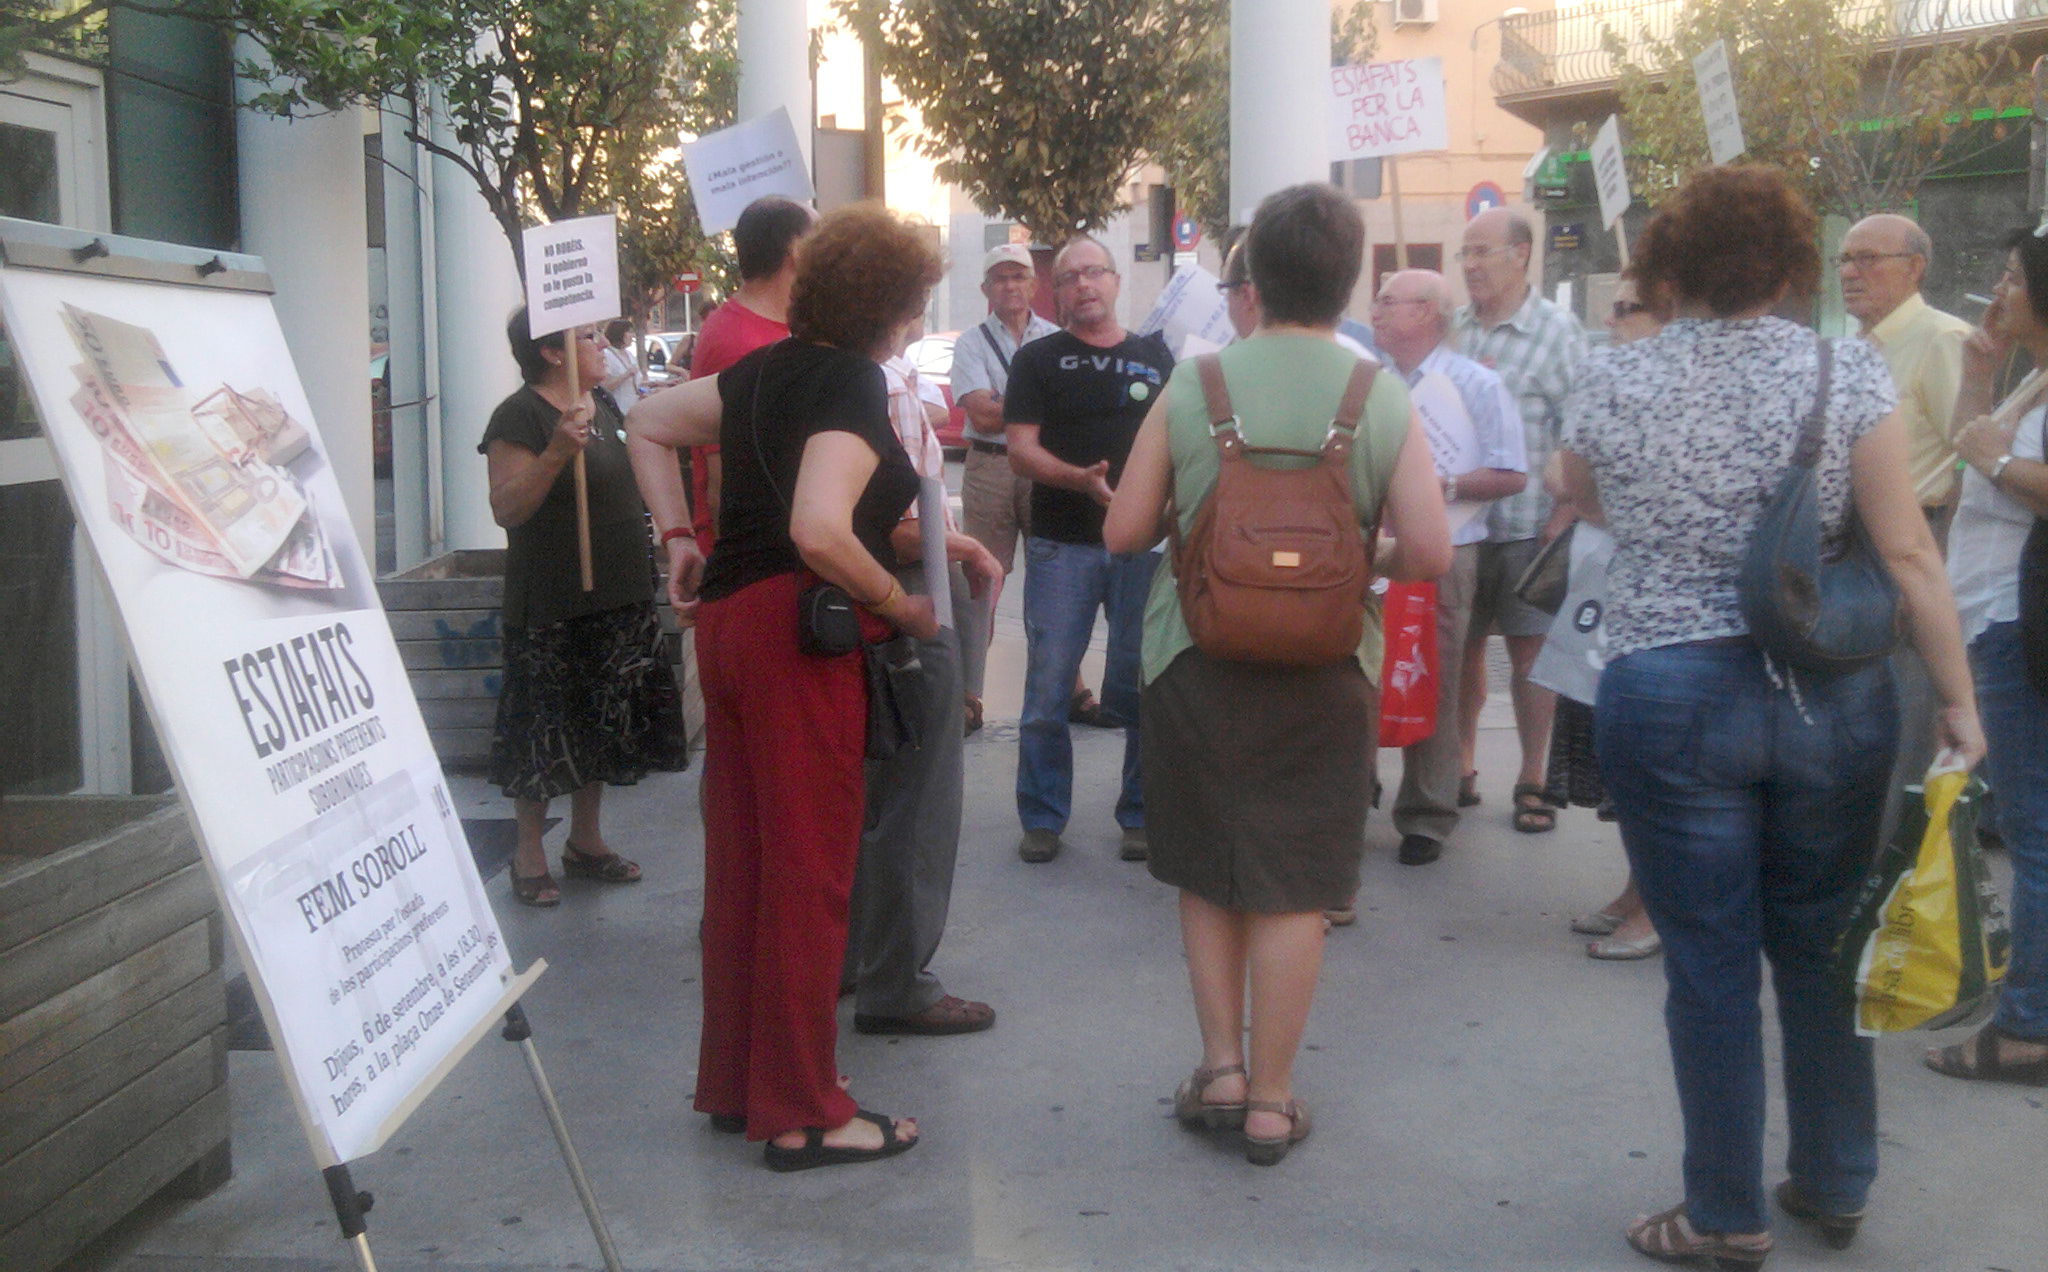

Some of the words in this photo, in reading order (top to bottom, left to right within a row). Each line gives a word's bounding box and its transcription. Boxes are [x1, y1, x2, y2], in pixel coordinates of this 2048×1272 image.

[1331, 59, 1418, 97] ESTAFATS
[1351, 92, 1390, 119] PER
[1395, 86, 1425, 111] LA
[1346, 115, 1422, 151] BANCA
[544, 244, 556, 258] NO
[551, 255, 589, 276] gobierno
[543, 281, 553, 294] no
[552, 279, 562, 291] le
[561, 273, 585, 291] gusta
[584, 271, 594, 284] la
[222, 621, 376, 760] ESTAFATS
[296, 870, 357, 934] FEM
[352, 823, 428, 899] SOROLL
[380, 916, 396, 941] per
[339, 975, 358, 996] les
[356, 931, 414, 989] participacions
[361, 1021, 374, 1044] 6
[374, 1012, 393, 1036] de
[436, 962, 447, 978] a
[443, 950, 460, 971] les
[330, 1076, 366, 1117] hores,
[366, 1063, 377, 1082] a
[373, 1051, 391, 1073] la
[390, 1024, 421, 1067] plaça
[417, 1000, 445, 1032] Onze
[441, 988, 456, 1007] de
